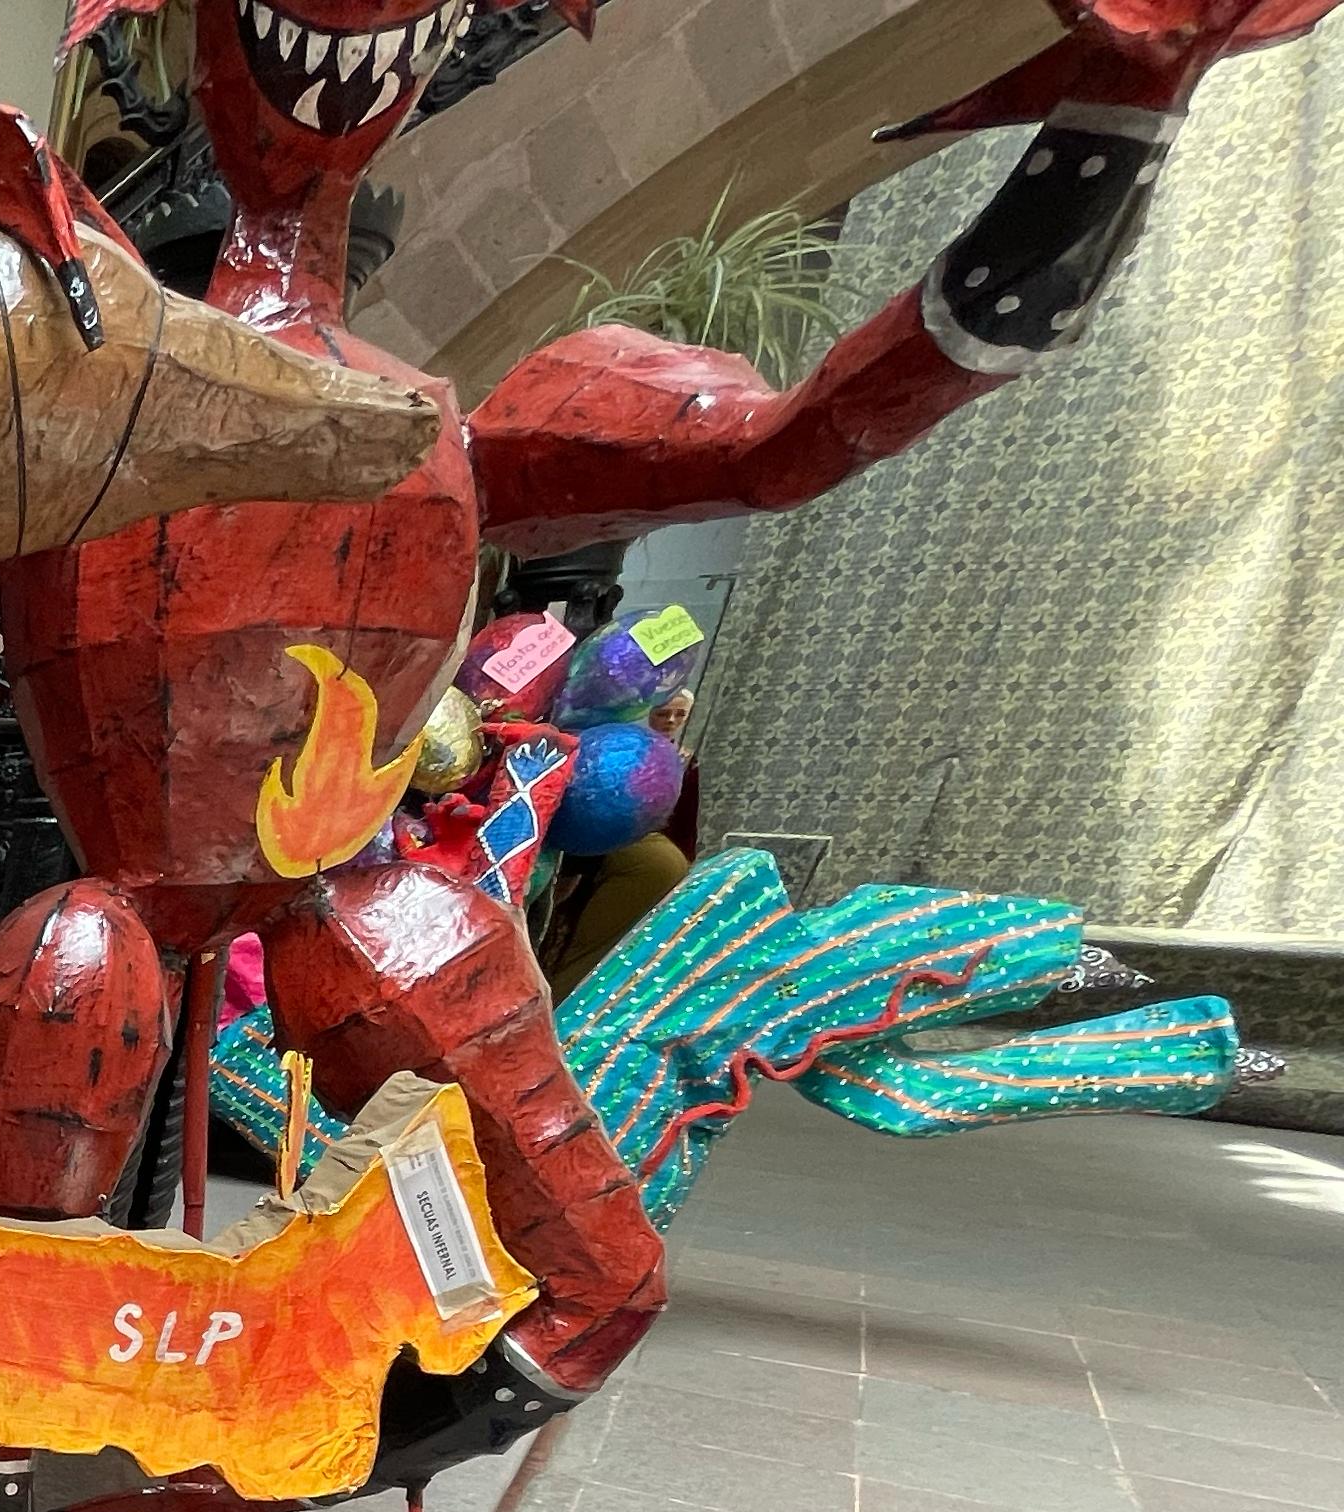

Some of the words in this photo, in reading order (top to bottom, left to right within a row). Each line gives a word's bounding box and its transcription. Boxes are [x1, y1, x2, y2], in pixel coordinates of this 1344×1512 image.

[491, 643, 537, 677] Hasta
[416, 1190, 439, 1232] SECUAS
[432, 1227, 457, 1281] INFERNAL
[109, 1303, 244, 1366] SLP
